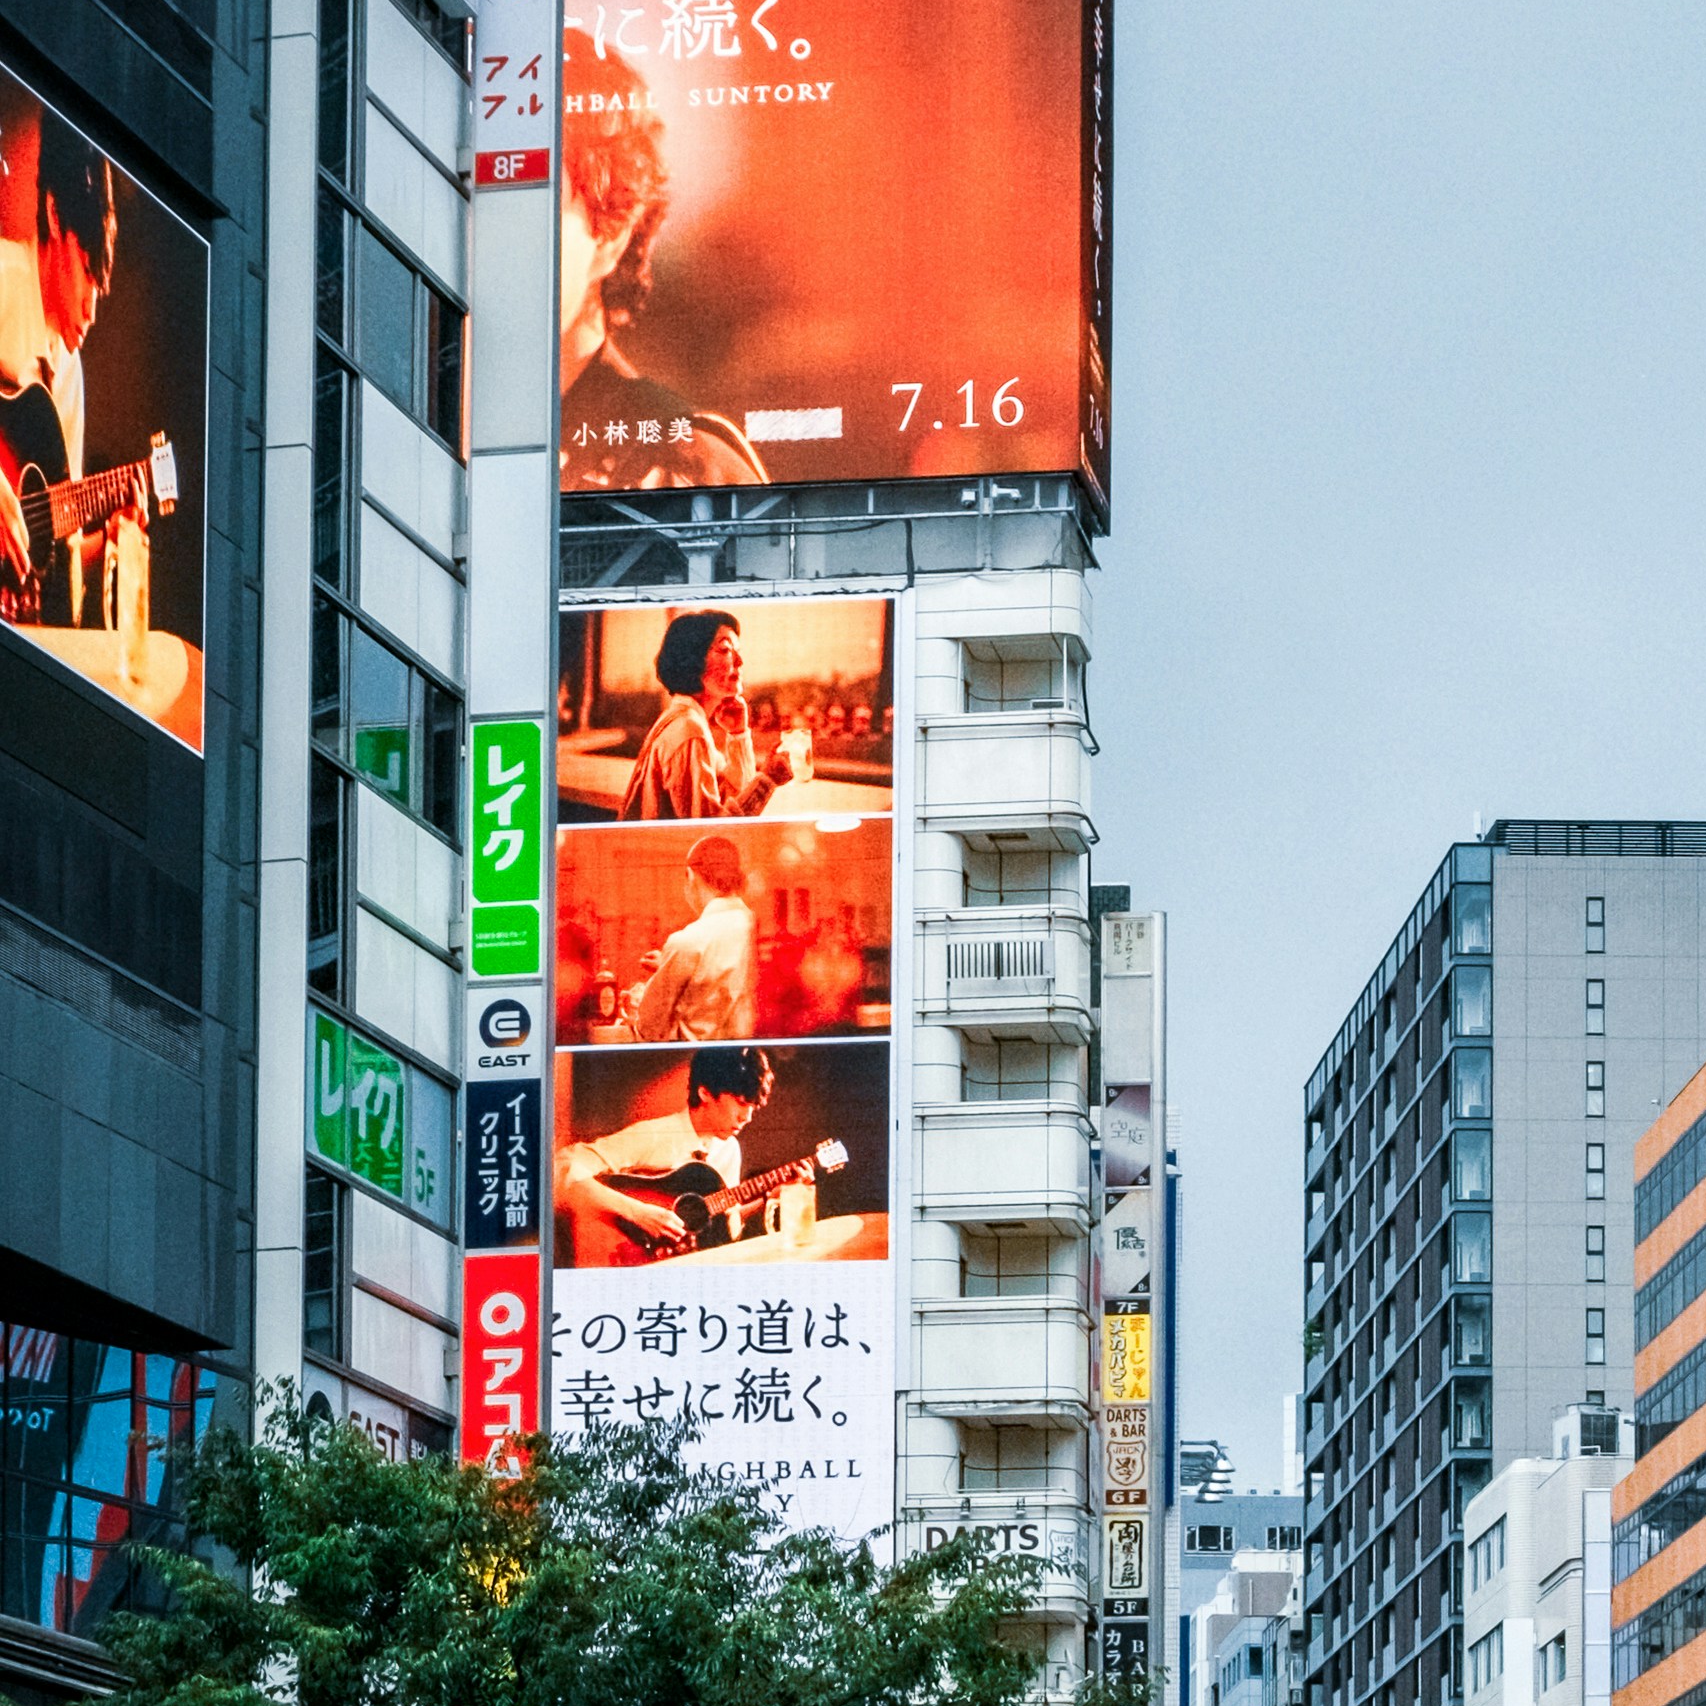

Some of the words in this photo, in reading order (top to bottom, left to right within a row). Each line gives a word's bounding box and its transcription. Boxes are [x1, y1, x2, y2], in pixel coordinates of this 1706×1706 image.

[687, 81, 836, 107] SUNTORY
[493, 153, 525, 181] 8F
[890, 375, 1026, 434] 7.16
[481, 744, 527, 872] レイク
[477, 1053, 532, 1069] EAST
[320, 1038, 398, 1150] レイク
[415, 1146, 435, 1208] 5F
[477, 1111, 502, 1217] クリニック
[505, 1092, 529, 1228] イースト駅前
[1116, 1302, 1140, 1314] 7F
[481, 1346, 525, 1481] アコム
[559, 1367, 848, 1429] 幸せに続く。
[1106, 1408, 1147, 1423] DARTS
[1122, 1423, 1146, 1438] BAR
[1113, 1600, 1138, 1615] 5F
